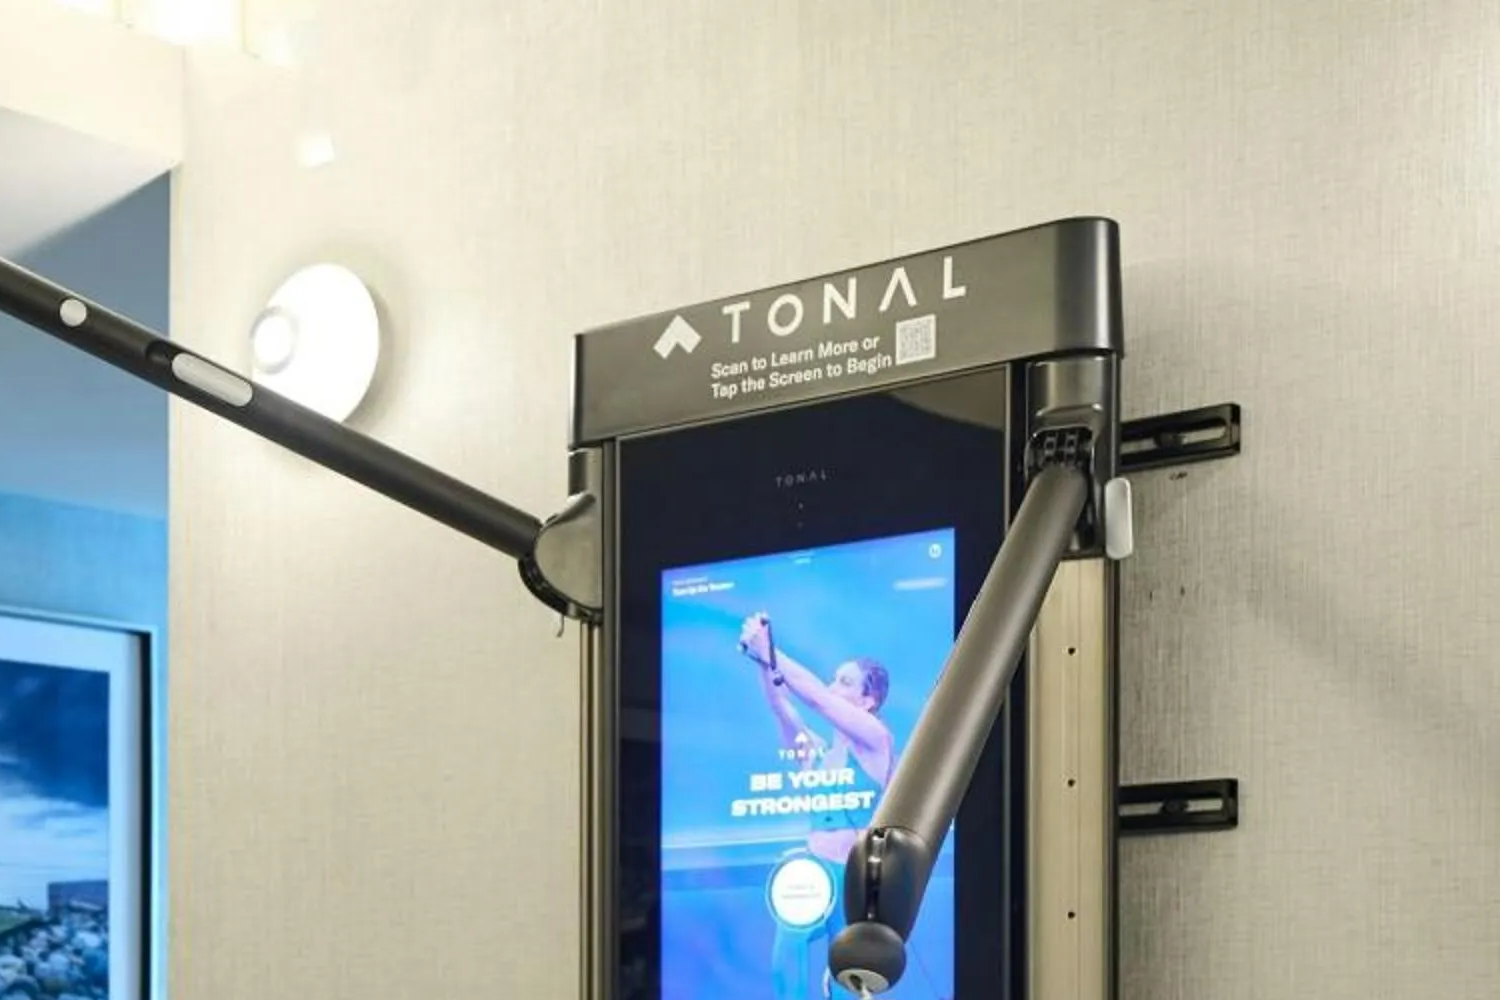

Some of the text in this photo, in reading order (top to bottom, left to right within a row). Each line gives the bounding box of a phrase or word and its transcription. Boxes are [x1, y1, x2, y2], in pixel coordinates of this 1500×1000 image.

[722, 256, 967, 343] TONAL
[711, 336, 880, 379] Scan to Learn More or
[711, 352, 892, 399] Tap the Screen to Begin
[776, 469, 826, 489] TONAL
[750, 767, 855, 792] BE YOUR
[731, 790, 876, 817] STRONGEST
